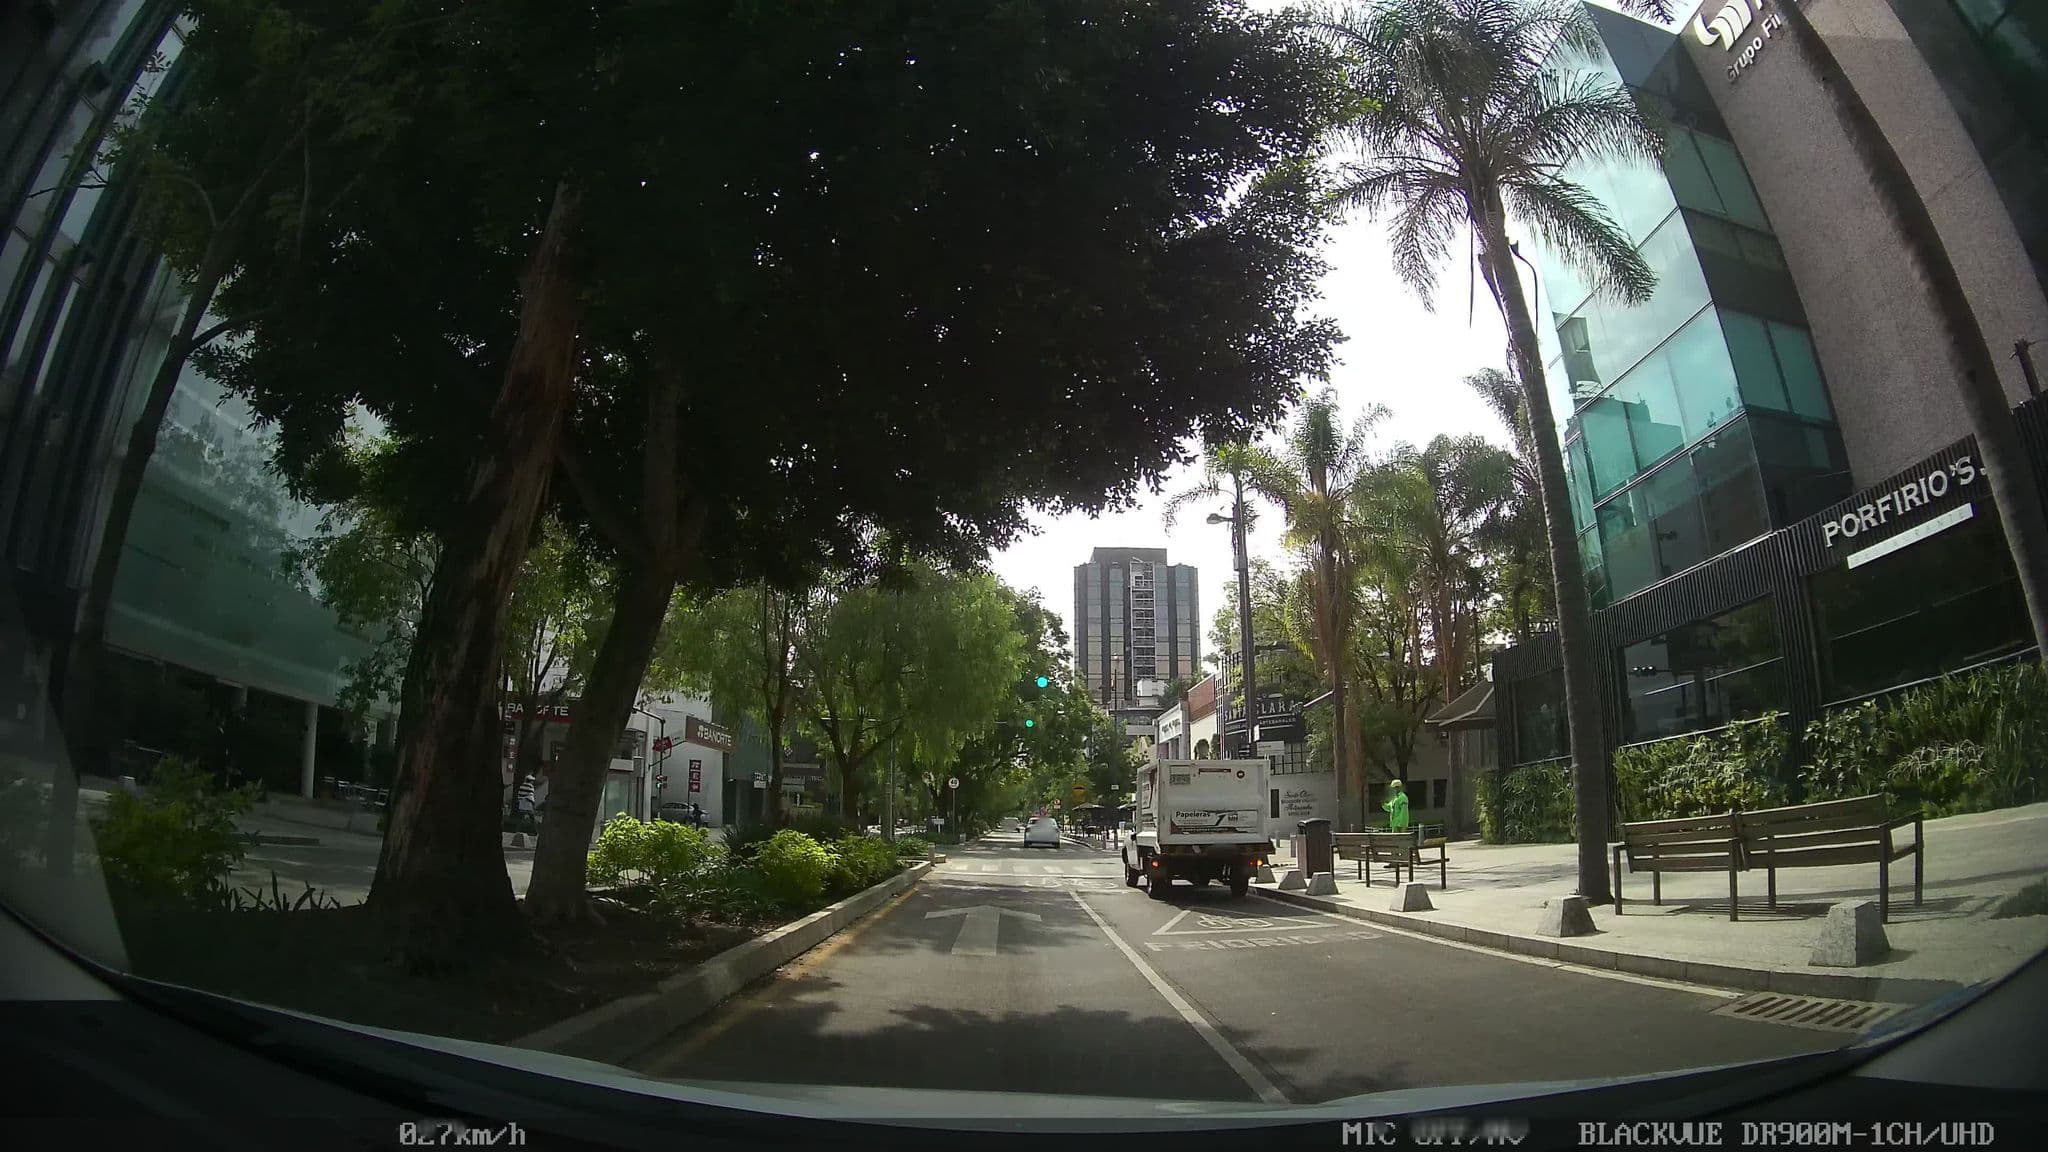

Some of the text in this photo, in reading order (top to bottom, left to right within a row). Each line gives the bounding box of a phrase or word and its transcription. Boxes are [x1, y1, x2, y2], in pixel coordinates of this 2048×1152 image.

[1727, 36, 1763, 82] Grupo
[704, 728, 732, 746] BANORTE
[1175, 810, 1211, 819] Papeleras
